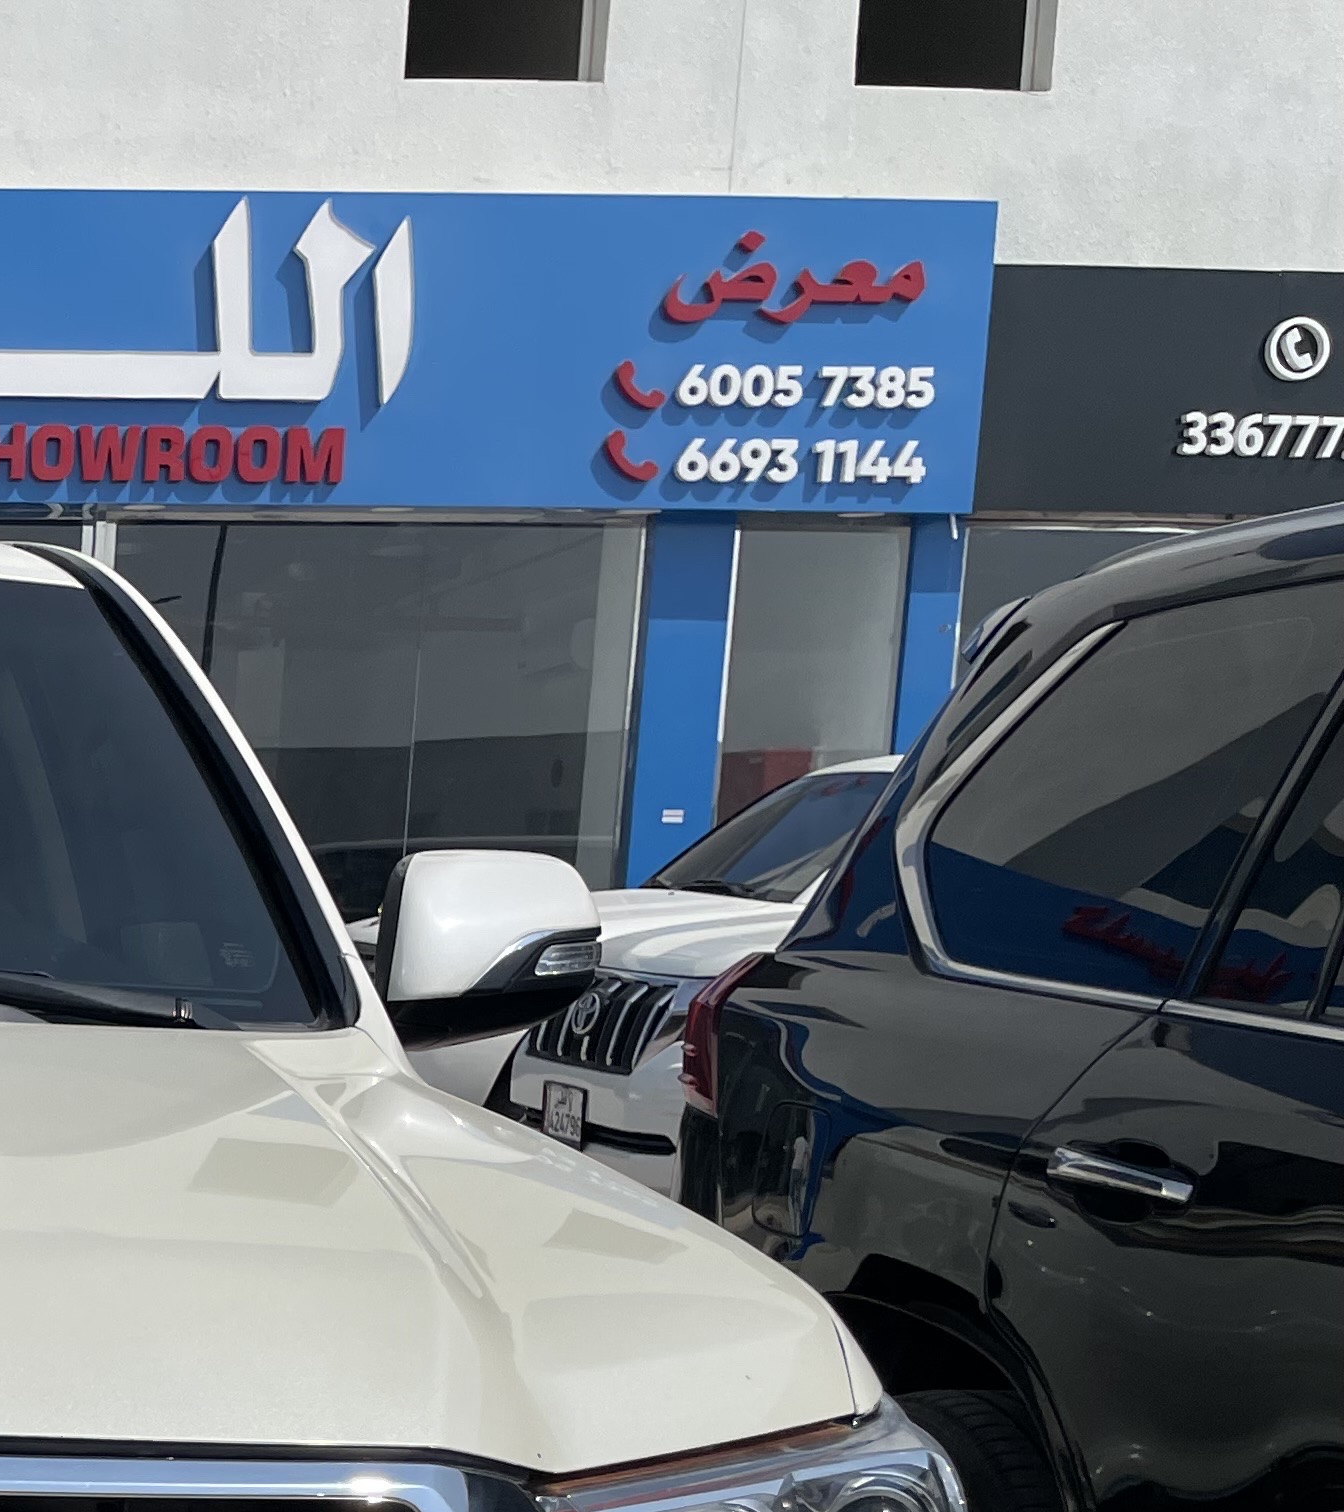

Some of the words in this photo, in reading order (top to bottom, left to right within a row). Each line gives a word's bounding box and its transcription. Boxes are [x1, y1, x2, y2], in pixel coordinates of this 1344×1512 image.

[663, 230, 926, 324] معرض
[677, 364, 802, 409] 6005
[819, 365, 936, 410] 7385
[1176, 410, 1344, 459] 336777
[674, 437, 799, 484] 6693
[815, 439, 927, 485] 1144
